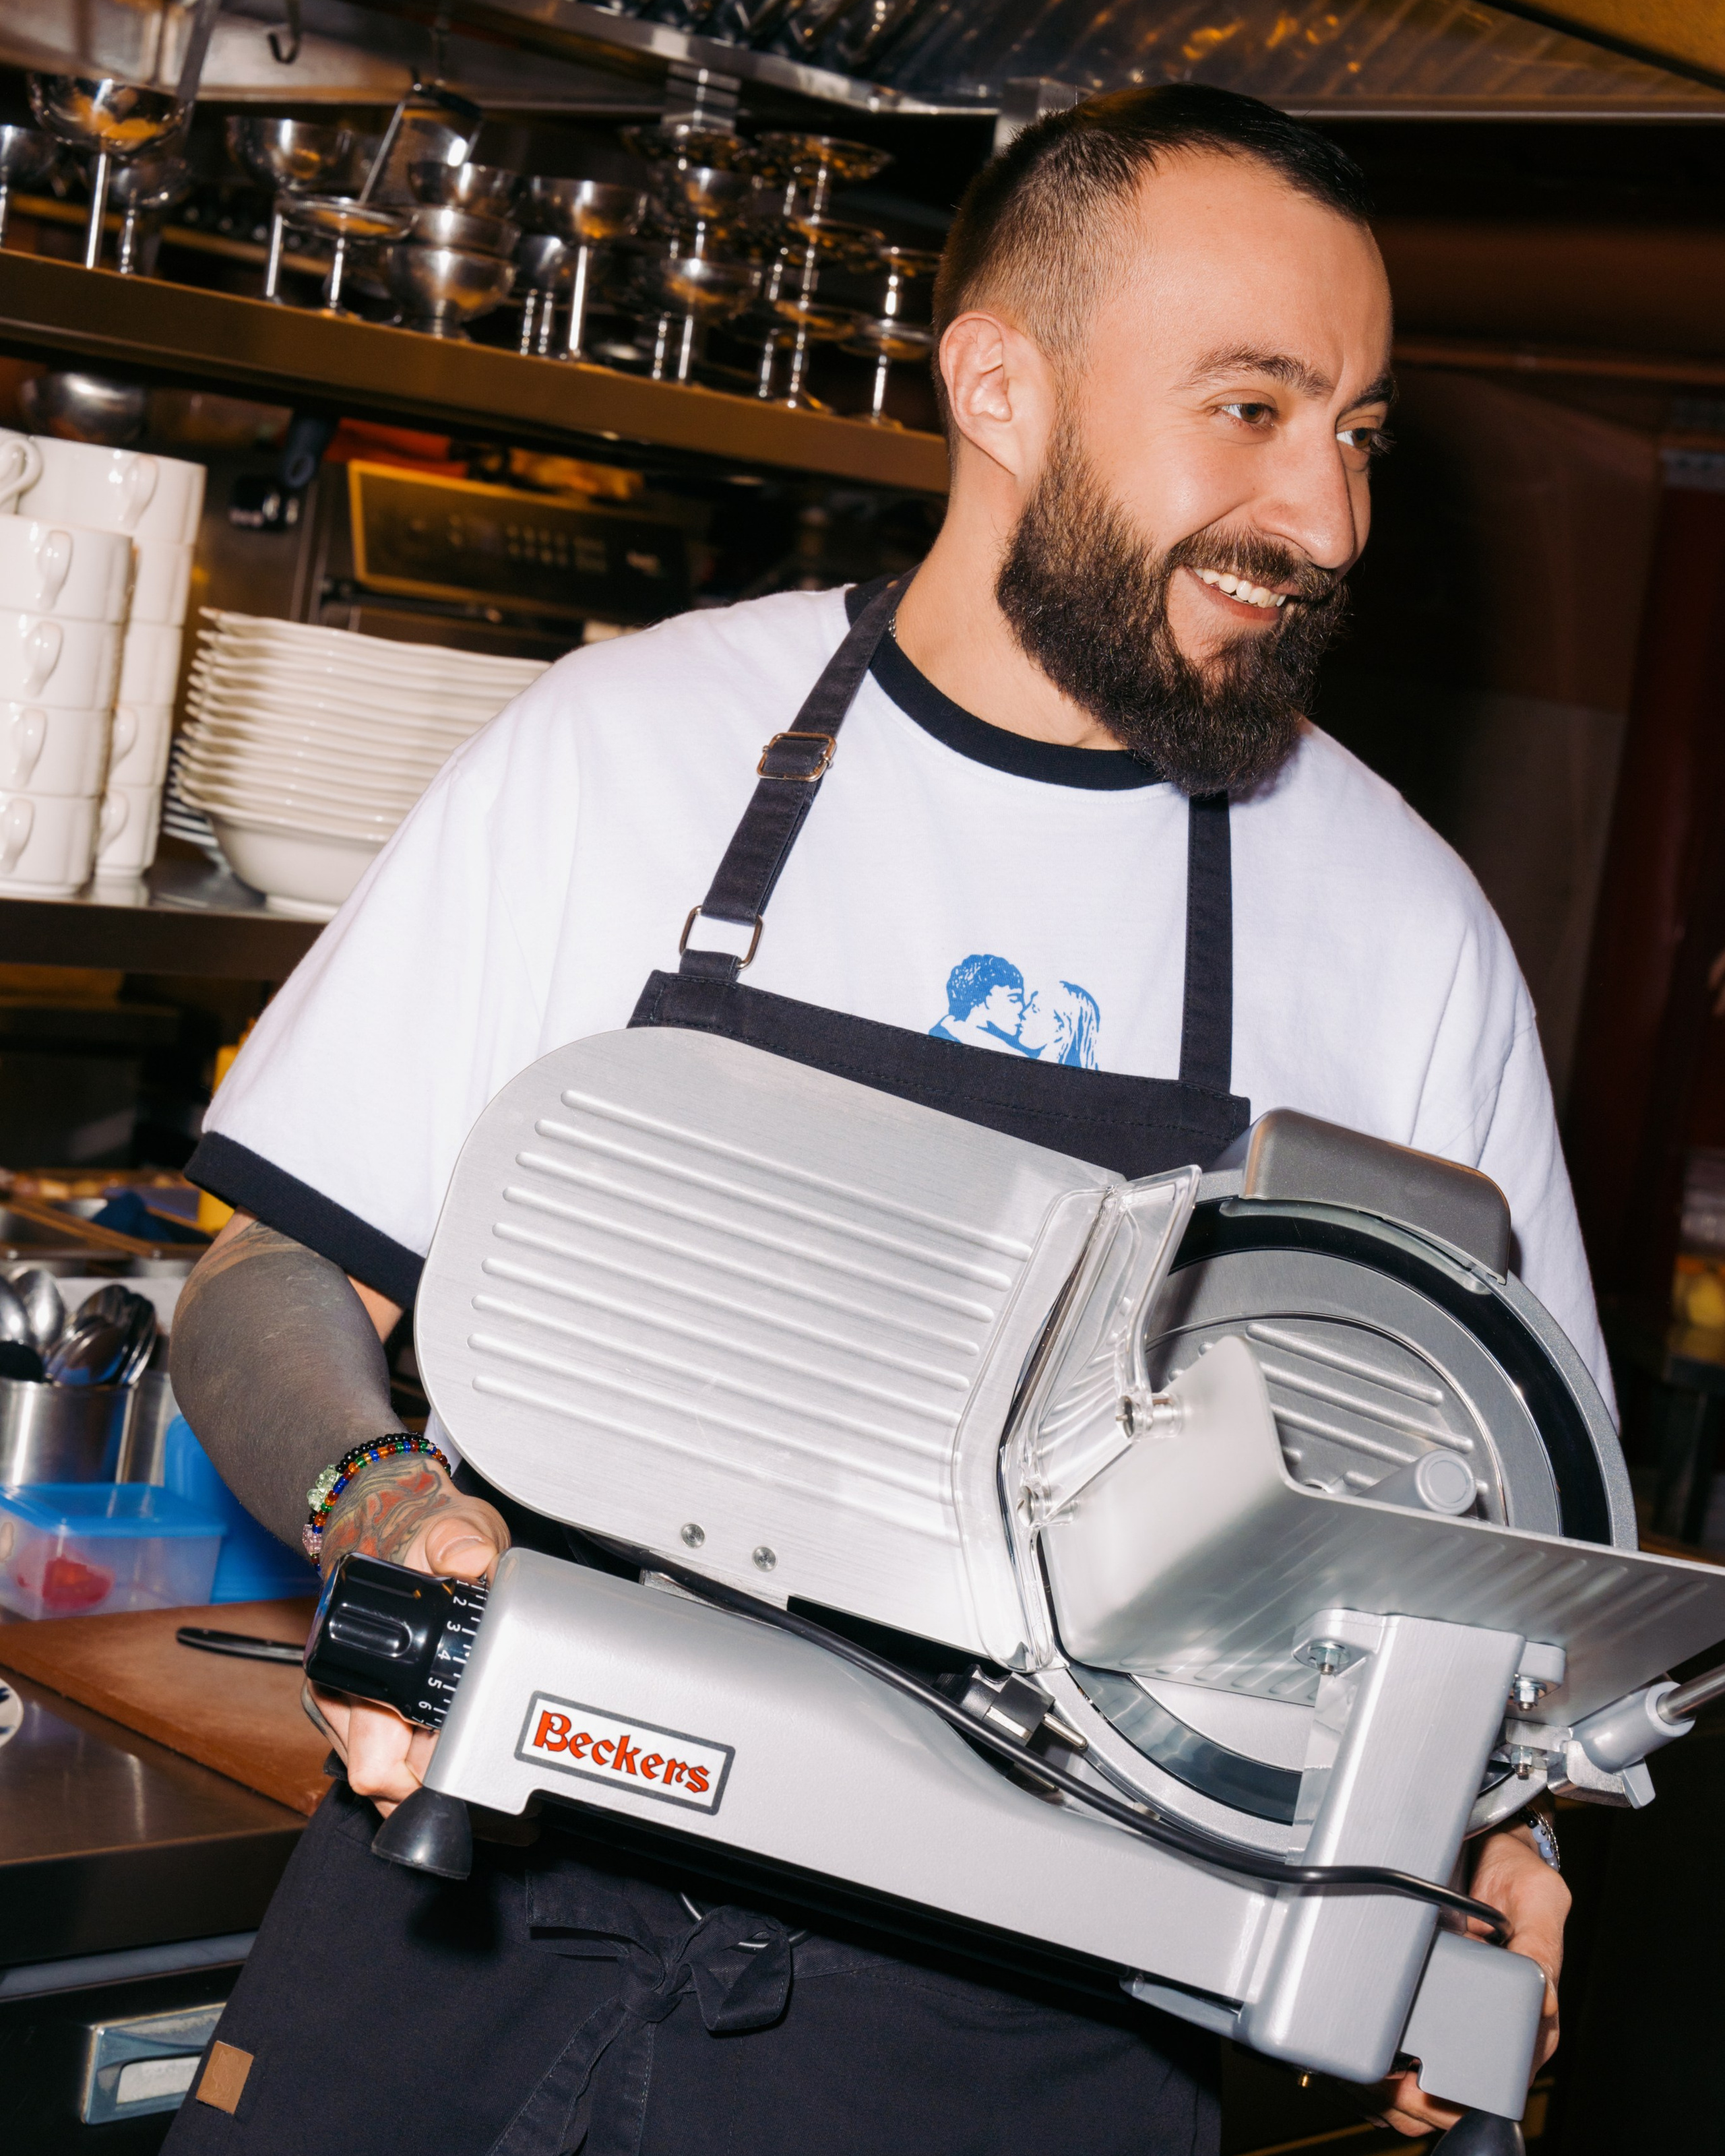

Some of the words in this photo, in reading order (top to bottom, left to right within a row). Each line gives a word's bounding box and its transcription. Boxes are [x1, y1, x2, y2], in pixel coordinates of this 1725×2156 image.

[453, 1596, 467, 1606] 2
[447, 1620, 461, 1632] 3
[437, 1649, 451, 1661] 4
[428, 1677, 442, 1689] 5
[418, 1701, 432, 1711] 6
[533, 1710, 710, 1794] Beckers
